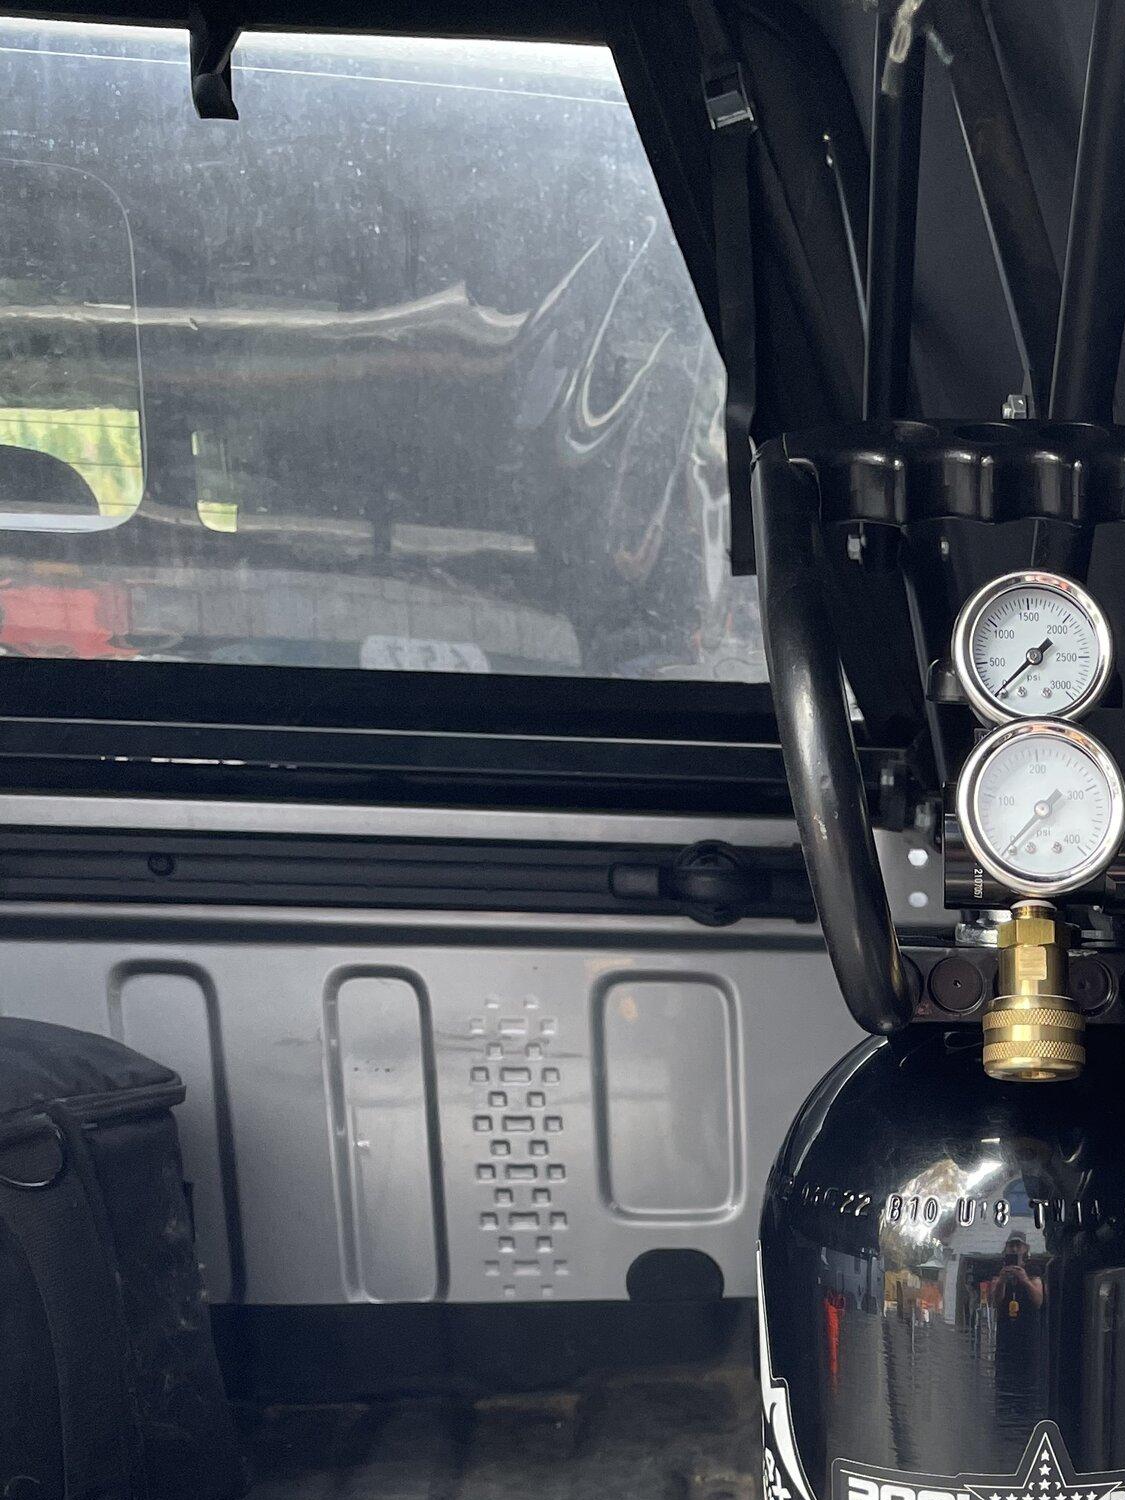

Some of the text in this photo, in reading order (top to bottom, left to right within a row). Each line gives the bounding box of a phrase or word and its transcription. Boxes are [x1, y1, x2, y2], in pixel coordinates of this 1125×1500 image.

[1018, 612, 1040, 622] 1500
[993, 629, 1015, 640] 1000
[1046, 624, 1068, 635] 2000
[989, 657, 1006, 668] 500
[1056, 652, 1077, 662] 2500
[1026, 673, 1041, 683] psi
[1050, 680, 1072, 691] 3000
[1029, 764, 1046, 775] 200
[998, 795, 1015, 807] 100
[1067, 790, 1084, 801] 300
[1036, 826, 1052, 838] psi
[1063, 834, 1081, 845] 400
